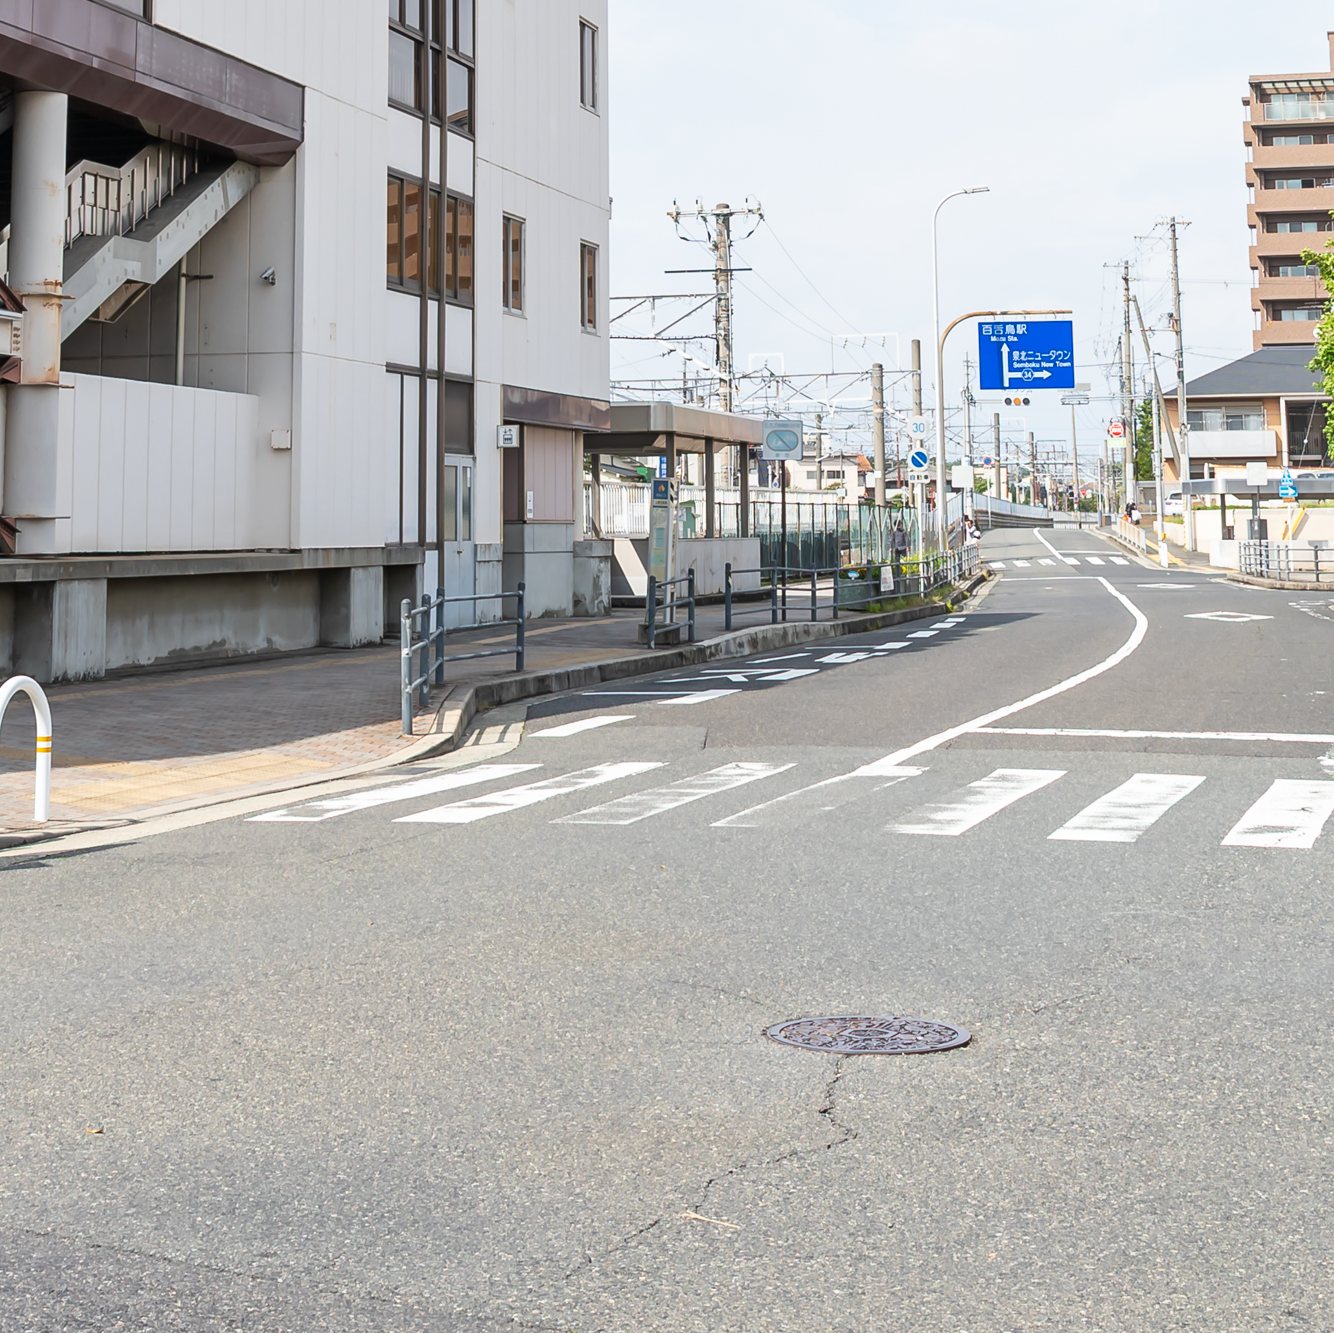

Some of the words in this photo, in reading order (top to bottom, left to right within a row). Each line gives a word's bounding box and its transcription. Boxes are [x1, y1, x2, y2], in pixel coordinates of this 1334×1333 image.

[982, 324, 1027, 335] 百舌鳥駅
[1012, 350, 1071, 361] 泉北ニュータウン
[912, 422, 926, 433] 30
